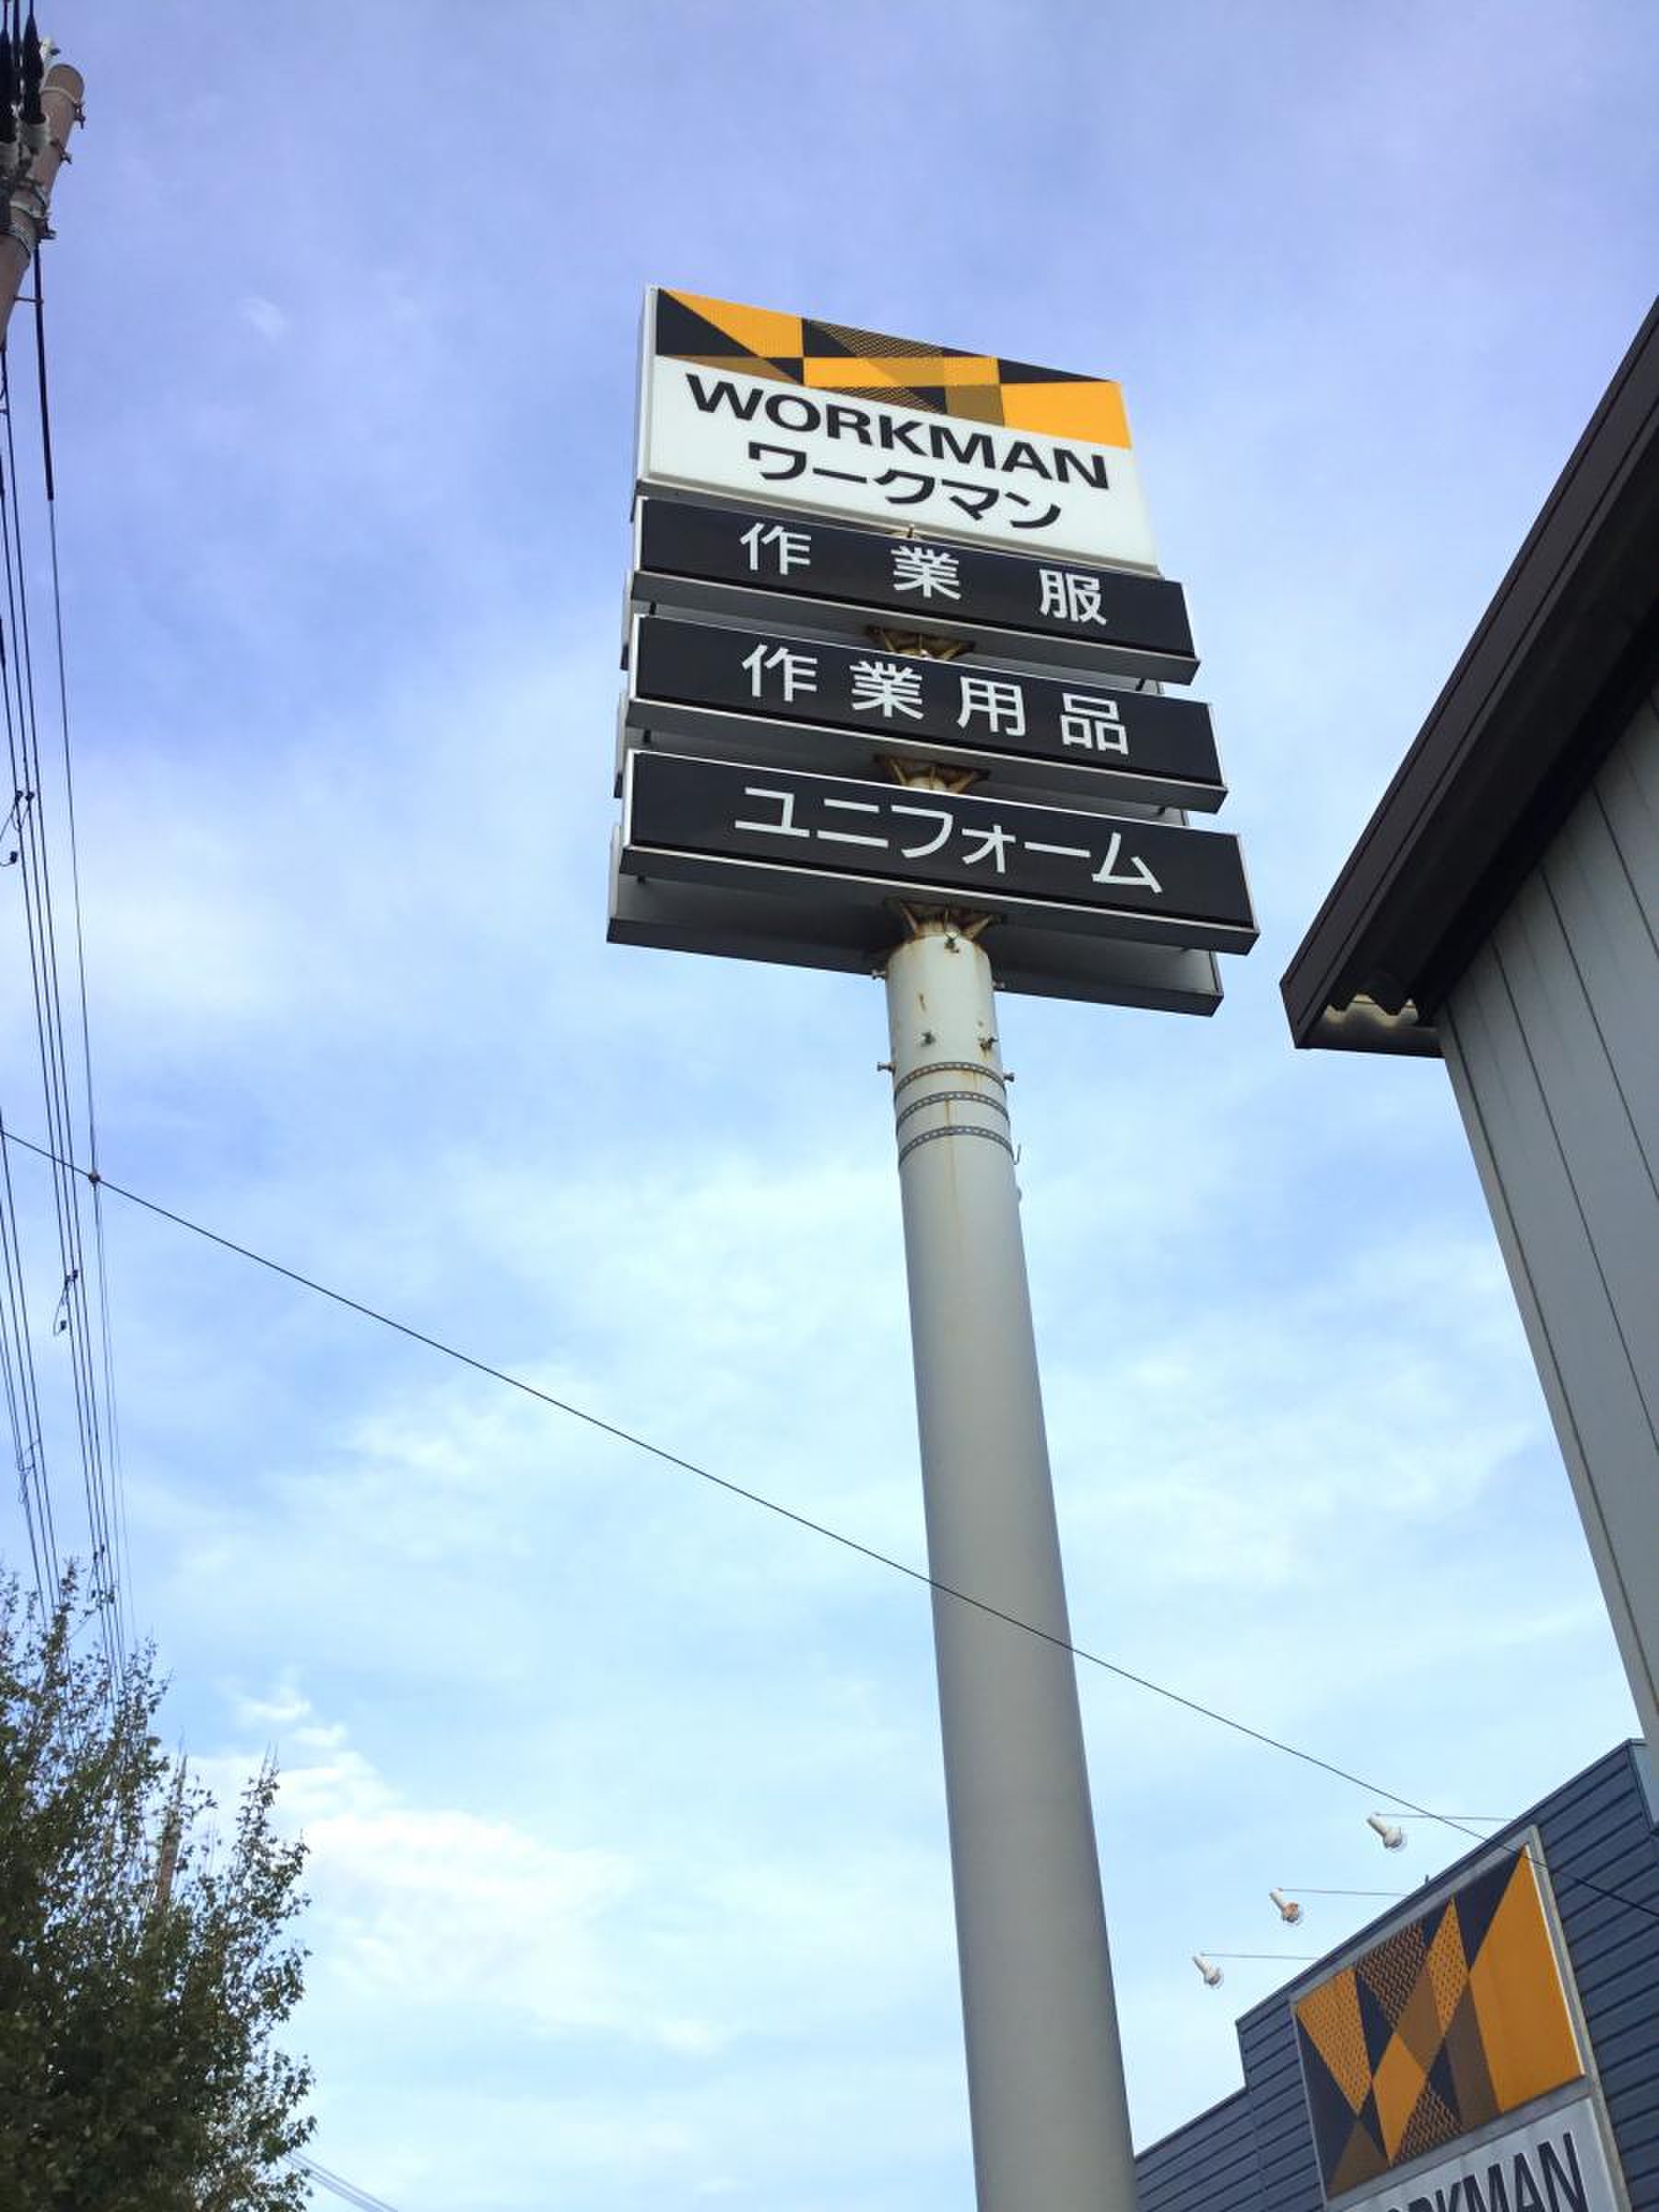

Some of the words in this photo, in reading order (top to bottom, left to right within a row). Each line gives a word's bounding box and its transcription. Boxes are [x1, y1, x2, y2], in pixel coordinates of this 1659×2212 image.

[686, 374, 1110, 489] WORKMAN
[747, 441, 1061, 529] ワークマン
[740, 523, 1108, 626] 作業服
[742, 644, 1130, 755] 作業用品
[735, 787, 1163, 894] ユニフォーム
